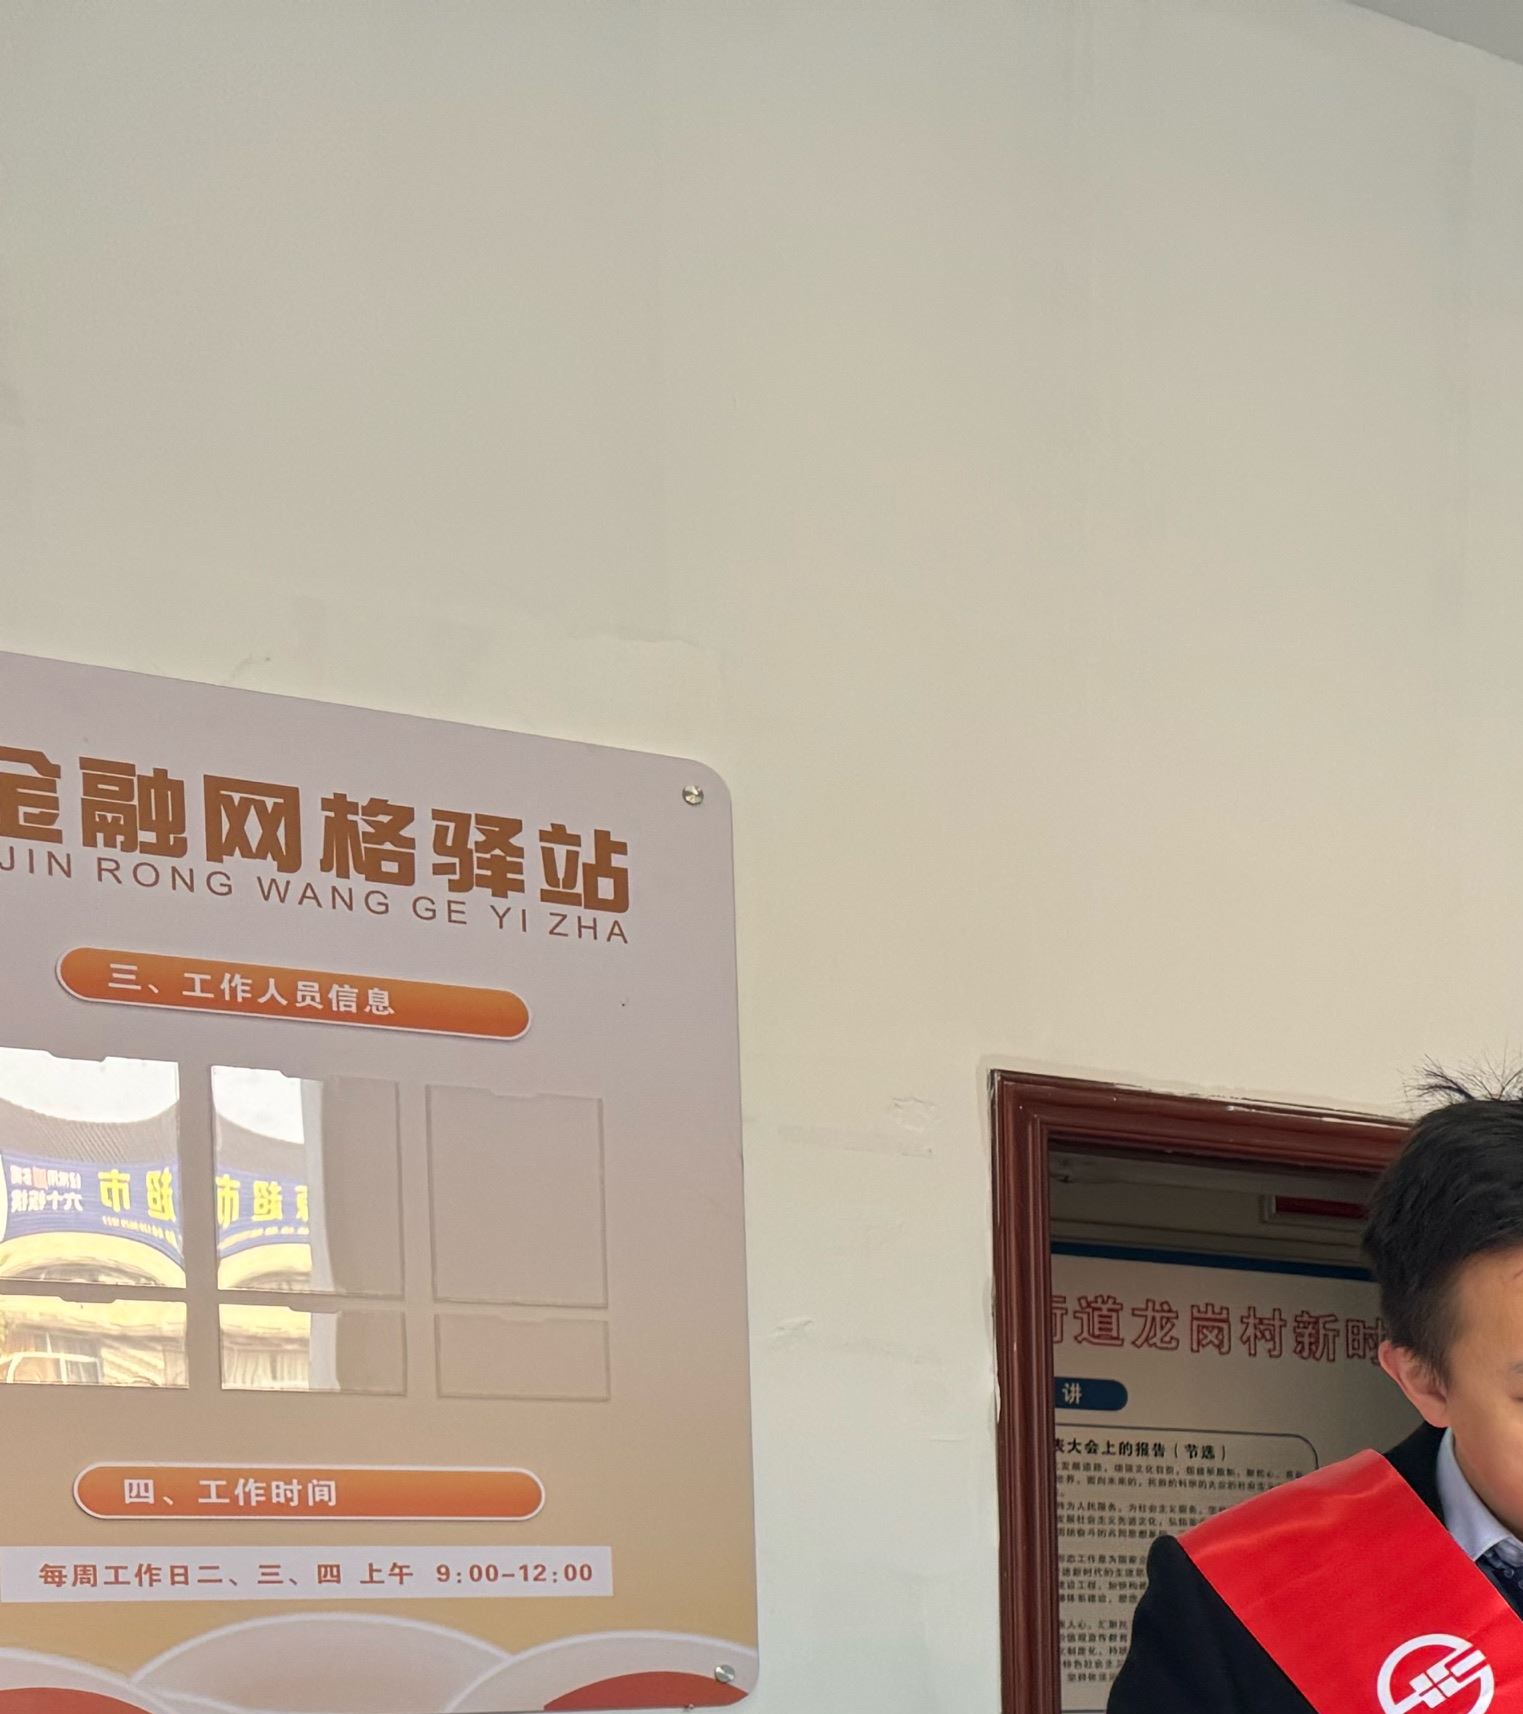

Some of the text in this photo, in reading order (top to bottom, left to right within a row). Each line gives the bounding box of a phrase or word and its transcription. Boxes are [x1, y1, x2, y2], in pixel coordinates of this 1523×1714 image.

[0, 846, 629, 944] JIN RONG WANG GE YI ZHA
[108, 961, 396, 1017] 三、工作人员信息
[124, 1478, 338, 1507] 四、工作时间
[39, 1562, 593, 1588] 每周工作日二、三、四 上午 9:00-12:00
